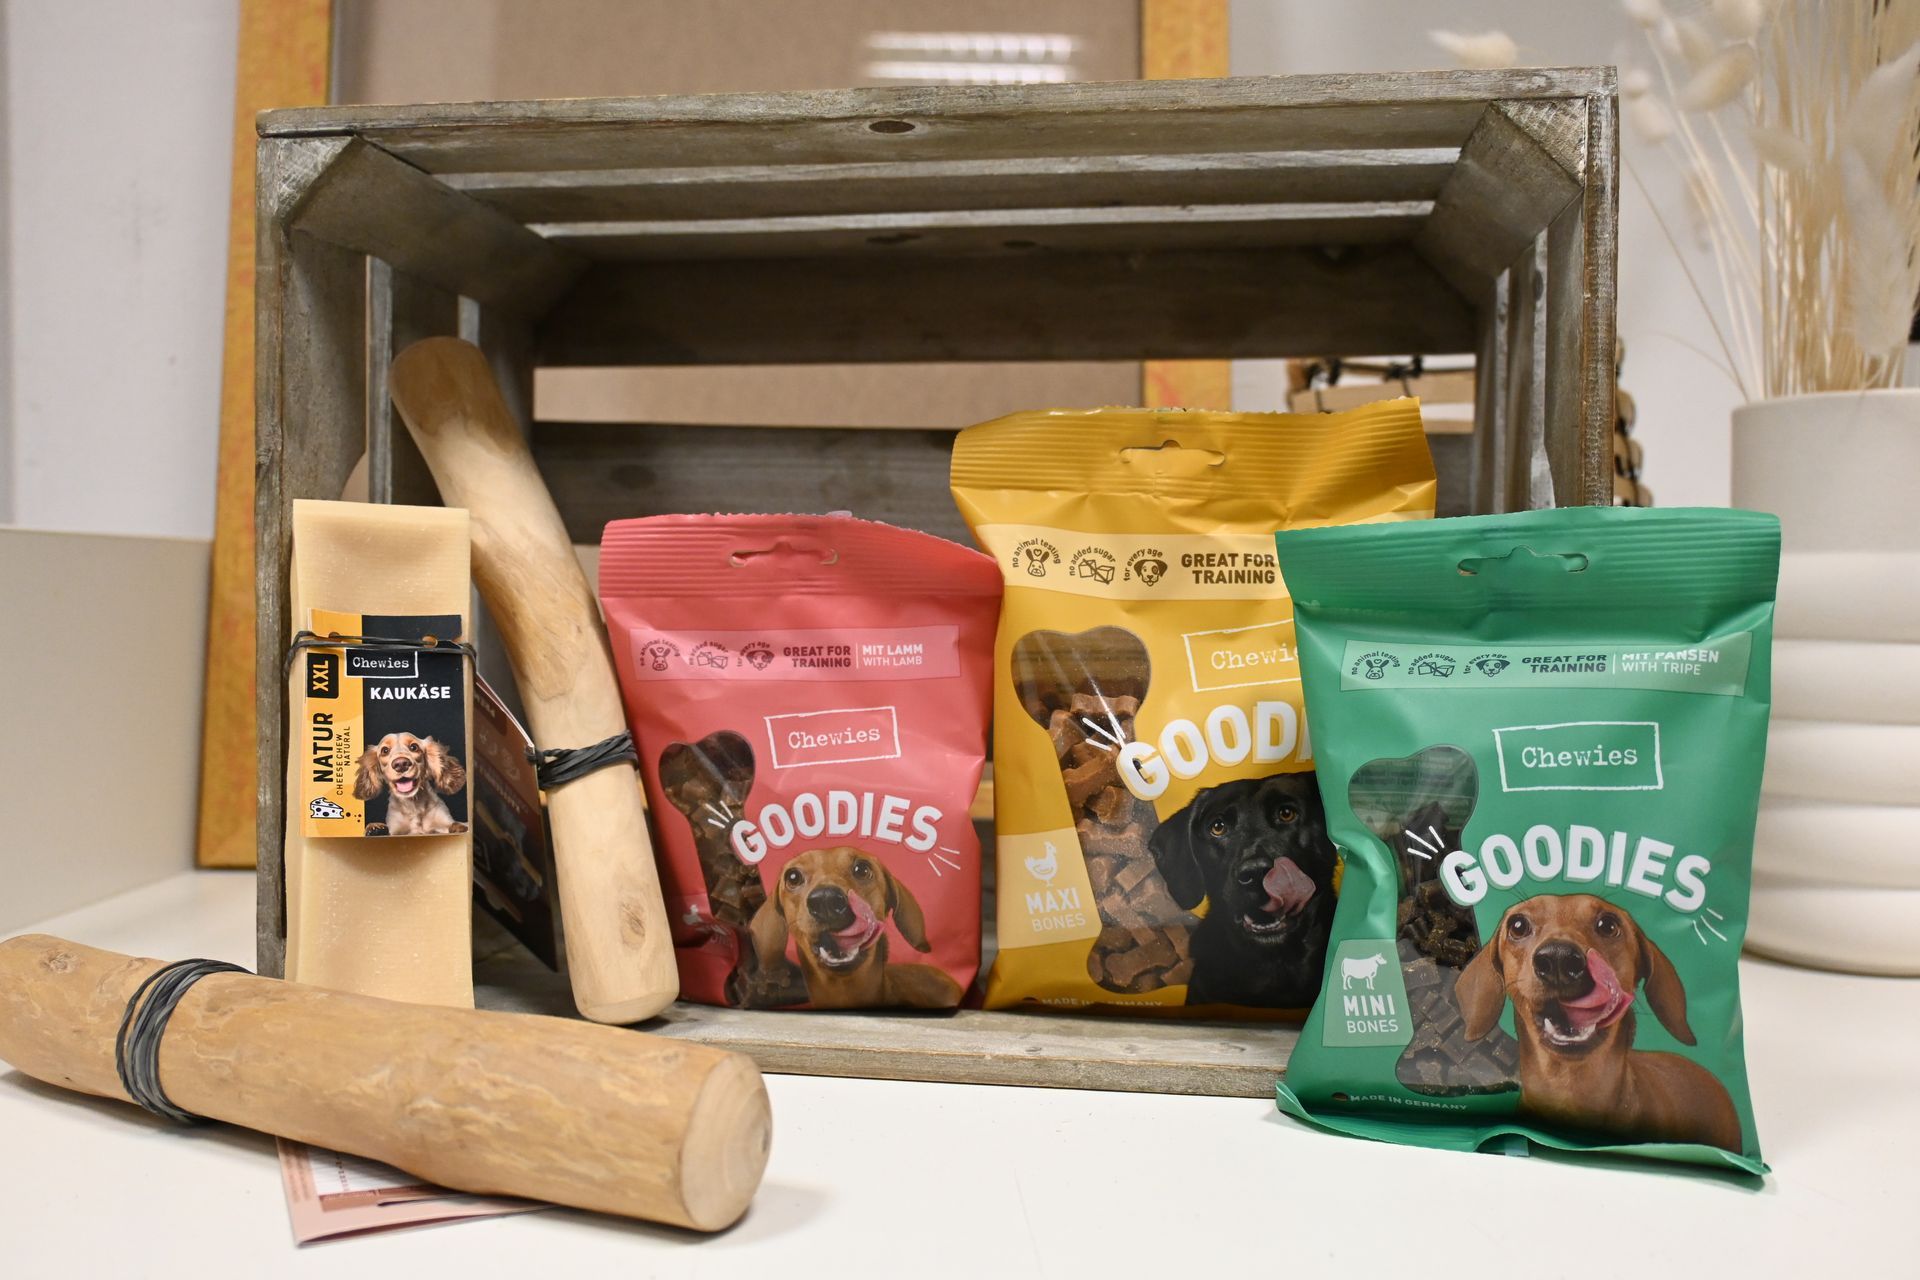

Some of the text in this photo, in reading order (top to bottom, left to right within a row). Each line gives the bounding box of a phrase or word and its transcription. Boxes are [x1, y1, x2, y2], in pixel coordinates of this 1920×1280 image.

[1012, 537, 1061, 568] no animal testing
[1069, 545, 1116, 576] no added sugar
[1181, 553, 1275, 568] GREAT FOR
[1123, 548, 1163, 581] for every age
[1192, 570, 1275, 584] TRAINING
[783, 645, 851, 656] GREAT FOR
[862, 643, 923, 655] MIT LAMM
[1622, 653, 1650, 661] MIT
[352, 656, 410, 669] Chewies
[792, 657, 851, 668] TRAINING
[863, 655, 923, 666] WITH LAMB
[1355, 651, 1379, 667] animal
[1381, 651, 1400, 668] testing
[1410, 653, 1433, 667] added
[1435, 653, 1457, 663] sugar
[1469, 653, 1490, 664] every
[1521, 654, 1607, 664] GREAT FOR
[313, 660, 329, 692] XXL
[1530, 663, 1606, 673] TRAINING
[1622, 662, 1701, 675] WITH TRIPE
[370, 684, 451, 700] KAUKÄSE
[788, 727, 881, 750] Chewies
[313, 712, 334, 783] NATUR
[1521, 744, 1638, 769] Chewies
[731, 790, 943, 864] GOODIES
[1440, 824, 1711, 913] GOODIES
[1025, 887, 1081, 915] MAXI
[1032, 913, 1086, 933] BONES
[1343, 993, 1394, 1017] MINI
[1346, 1018, 1399, 1034] BONES
[1389, 1096, 1402, 1104] IN
[1405, 1100, 1467, 1110] GERMANY
